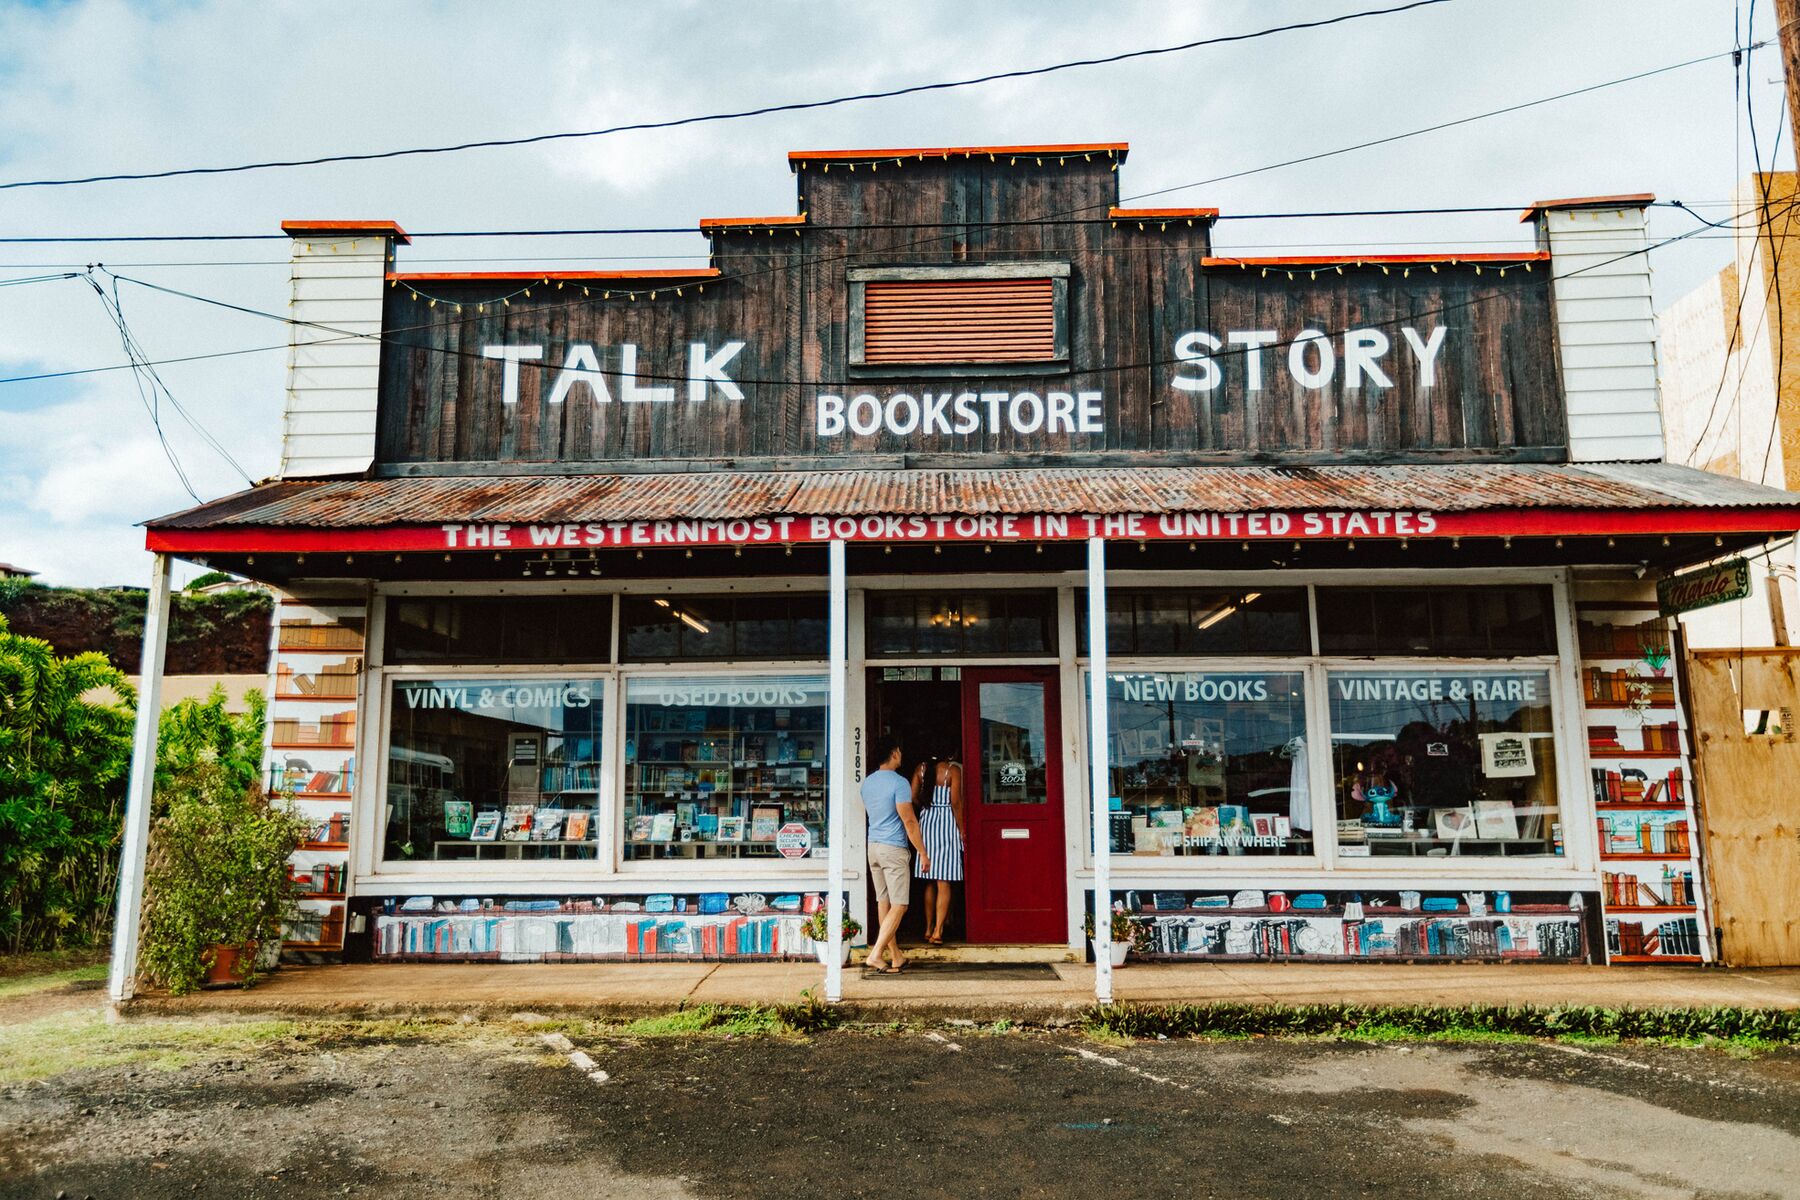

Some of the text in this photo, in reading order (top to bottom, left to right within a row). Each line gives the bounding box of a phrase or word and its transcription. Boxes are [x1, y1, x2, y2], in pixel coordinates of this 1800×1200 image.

[483, 342, 747, 403] TALK
[1171, 326, 1448, 391] STORY
[817, 392, 1103, 436] BOOKSTORE
[442, 511, 1437, 547] THE WESTERNMOST BOOKSTORE IN THE UNITED STATES
[1670, 572, 1729, 606] Mahalo
[406, 687, 591, 709] VINYL & COMICS
[660, 685, 808, 706] USED BOOKS
[1124, 680, 1268, 701] NEW BOOKS
[1338, 680, 1537, 700] VINTAGE & RARE
[1161, 836, 1287, 848] WE SHIP ANYWHERE
